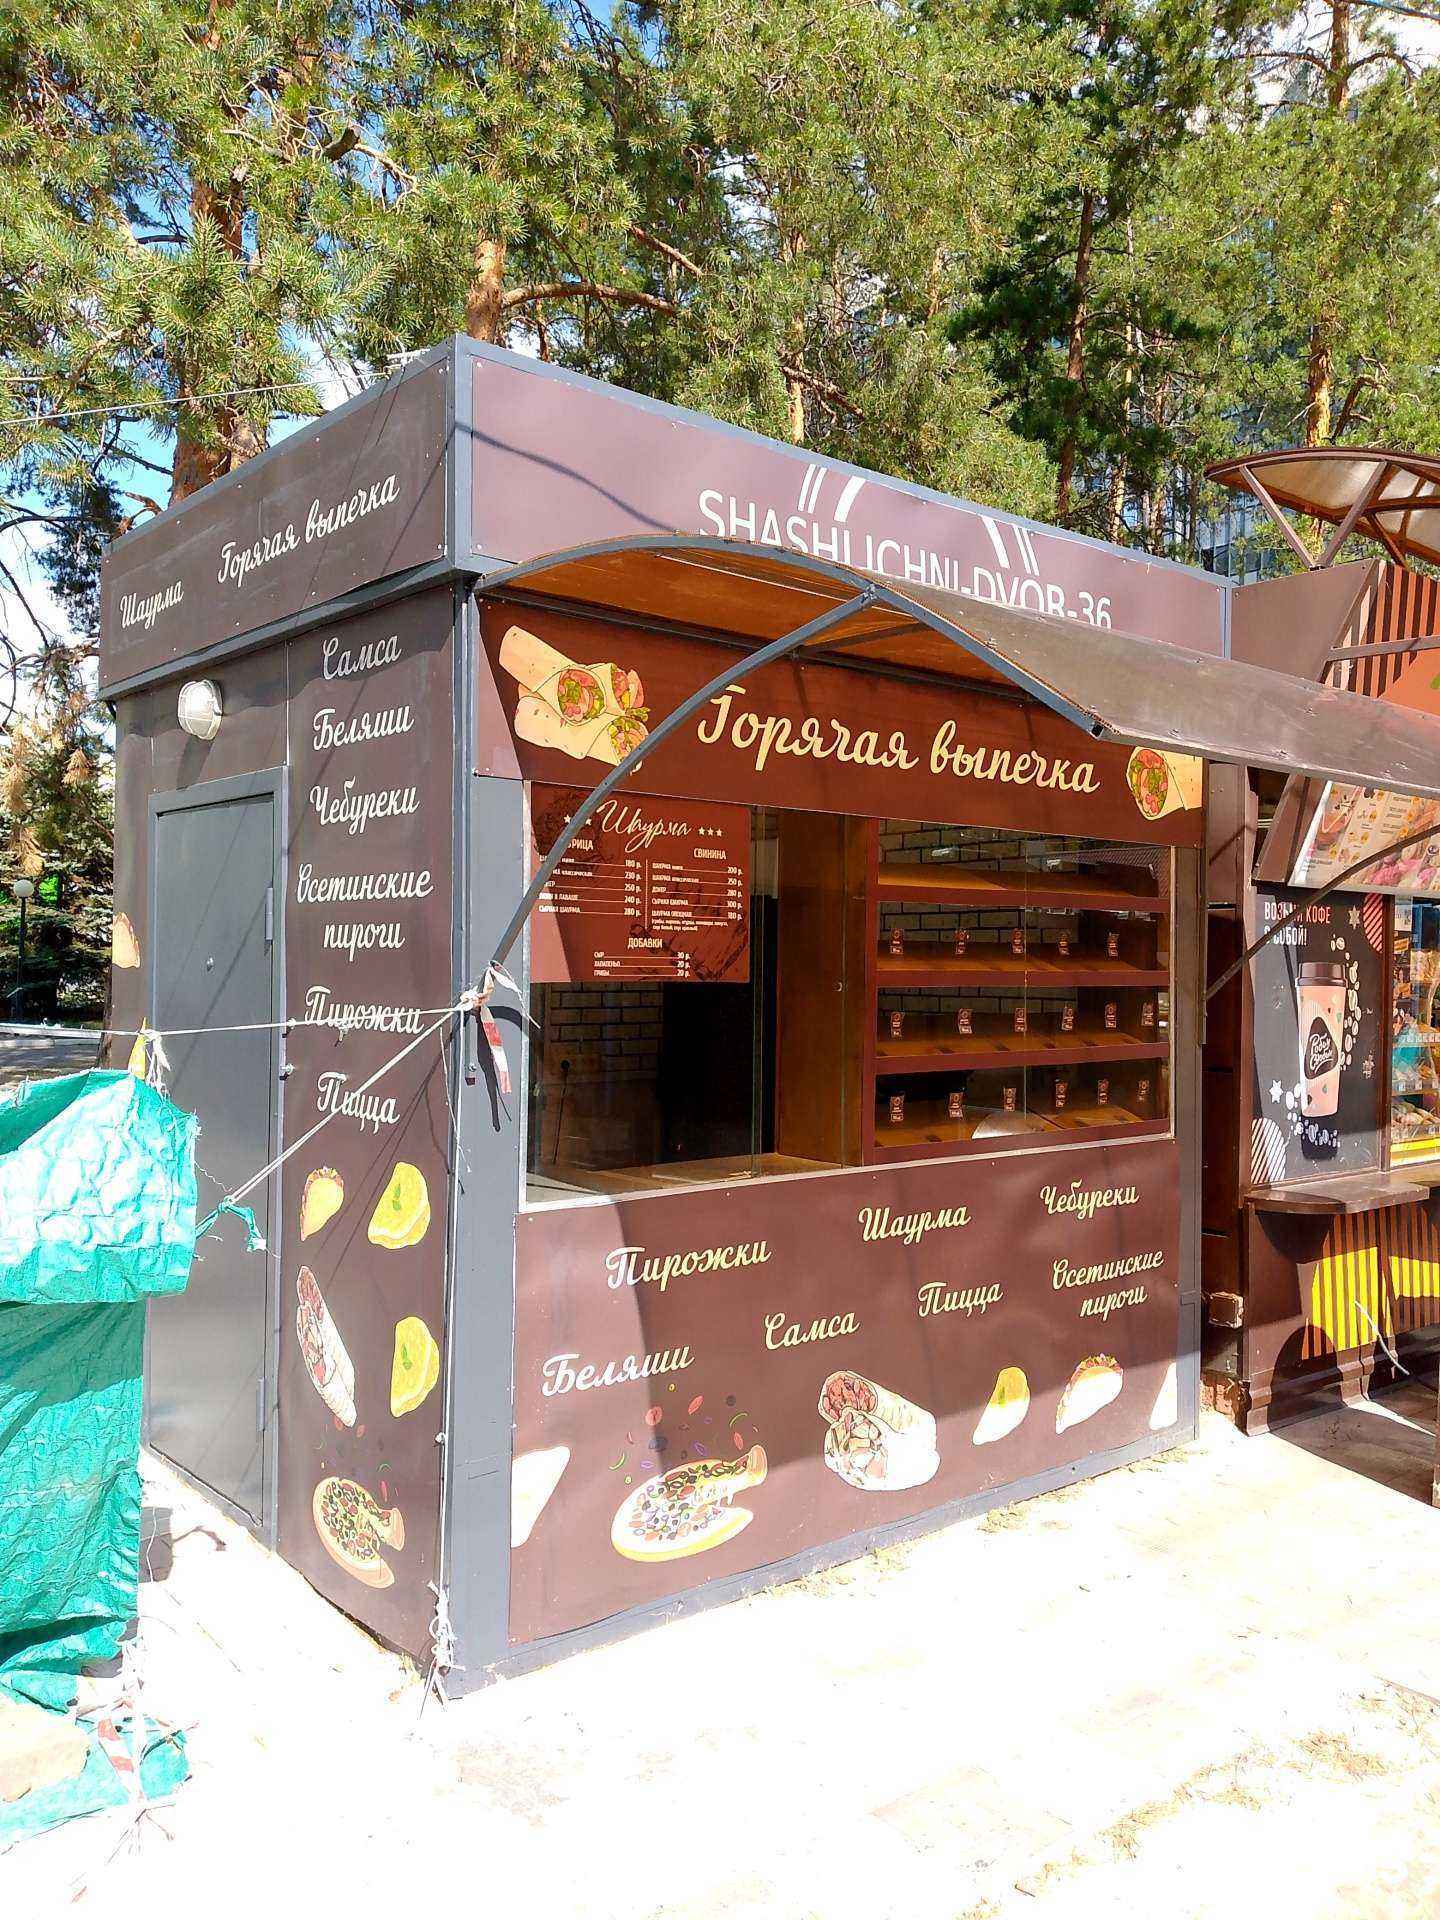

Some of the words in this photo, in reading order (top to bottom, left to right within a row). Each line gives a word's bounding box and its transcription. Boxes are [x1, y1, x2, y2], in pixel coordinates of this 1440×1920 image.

[217, 524, 301, 587] Горячая
[306, 474, 400, 543] выпечка
[120, 580, 184, 630] Шаурма
[322, 634, 402, 680] Самса
[313, 704, 414, 750] Беляши
[697, 684, 920, 772] Горячая
[929, 720, 1101, 793] выпечка
[310, 776, 420, 834] Чебуреки
[596, 799, 692, 853] Шаурма
[694, 848, 727, 860] СВИНИНА
[297, 863, 433, 903] Осетинские
[1305, 906, 1331, 925] КОФЕ
[323, 921, 405, 962] пироги
[628, 937, 663, 950] ДОБАВКИ
[304, 986, 425, 1041] Пирожки
[317, 1071, 400, 1134] Пицца
[1040, 1178, 1140, 1220] Чебуреки
[858, 1205, 972, 1245] Шаурма
[606, 1240, 772, 1292] Пирожки
[1052, 1250, 1164, 1290] Осетинские
[918, 1281, 1003, 1318] Пицца
[1079, 1285, 1148, 1321] пироги
[764, 1312, 860, 1350] Самса
[542, 1345, 695, 1397] Беляши
